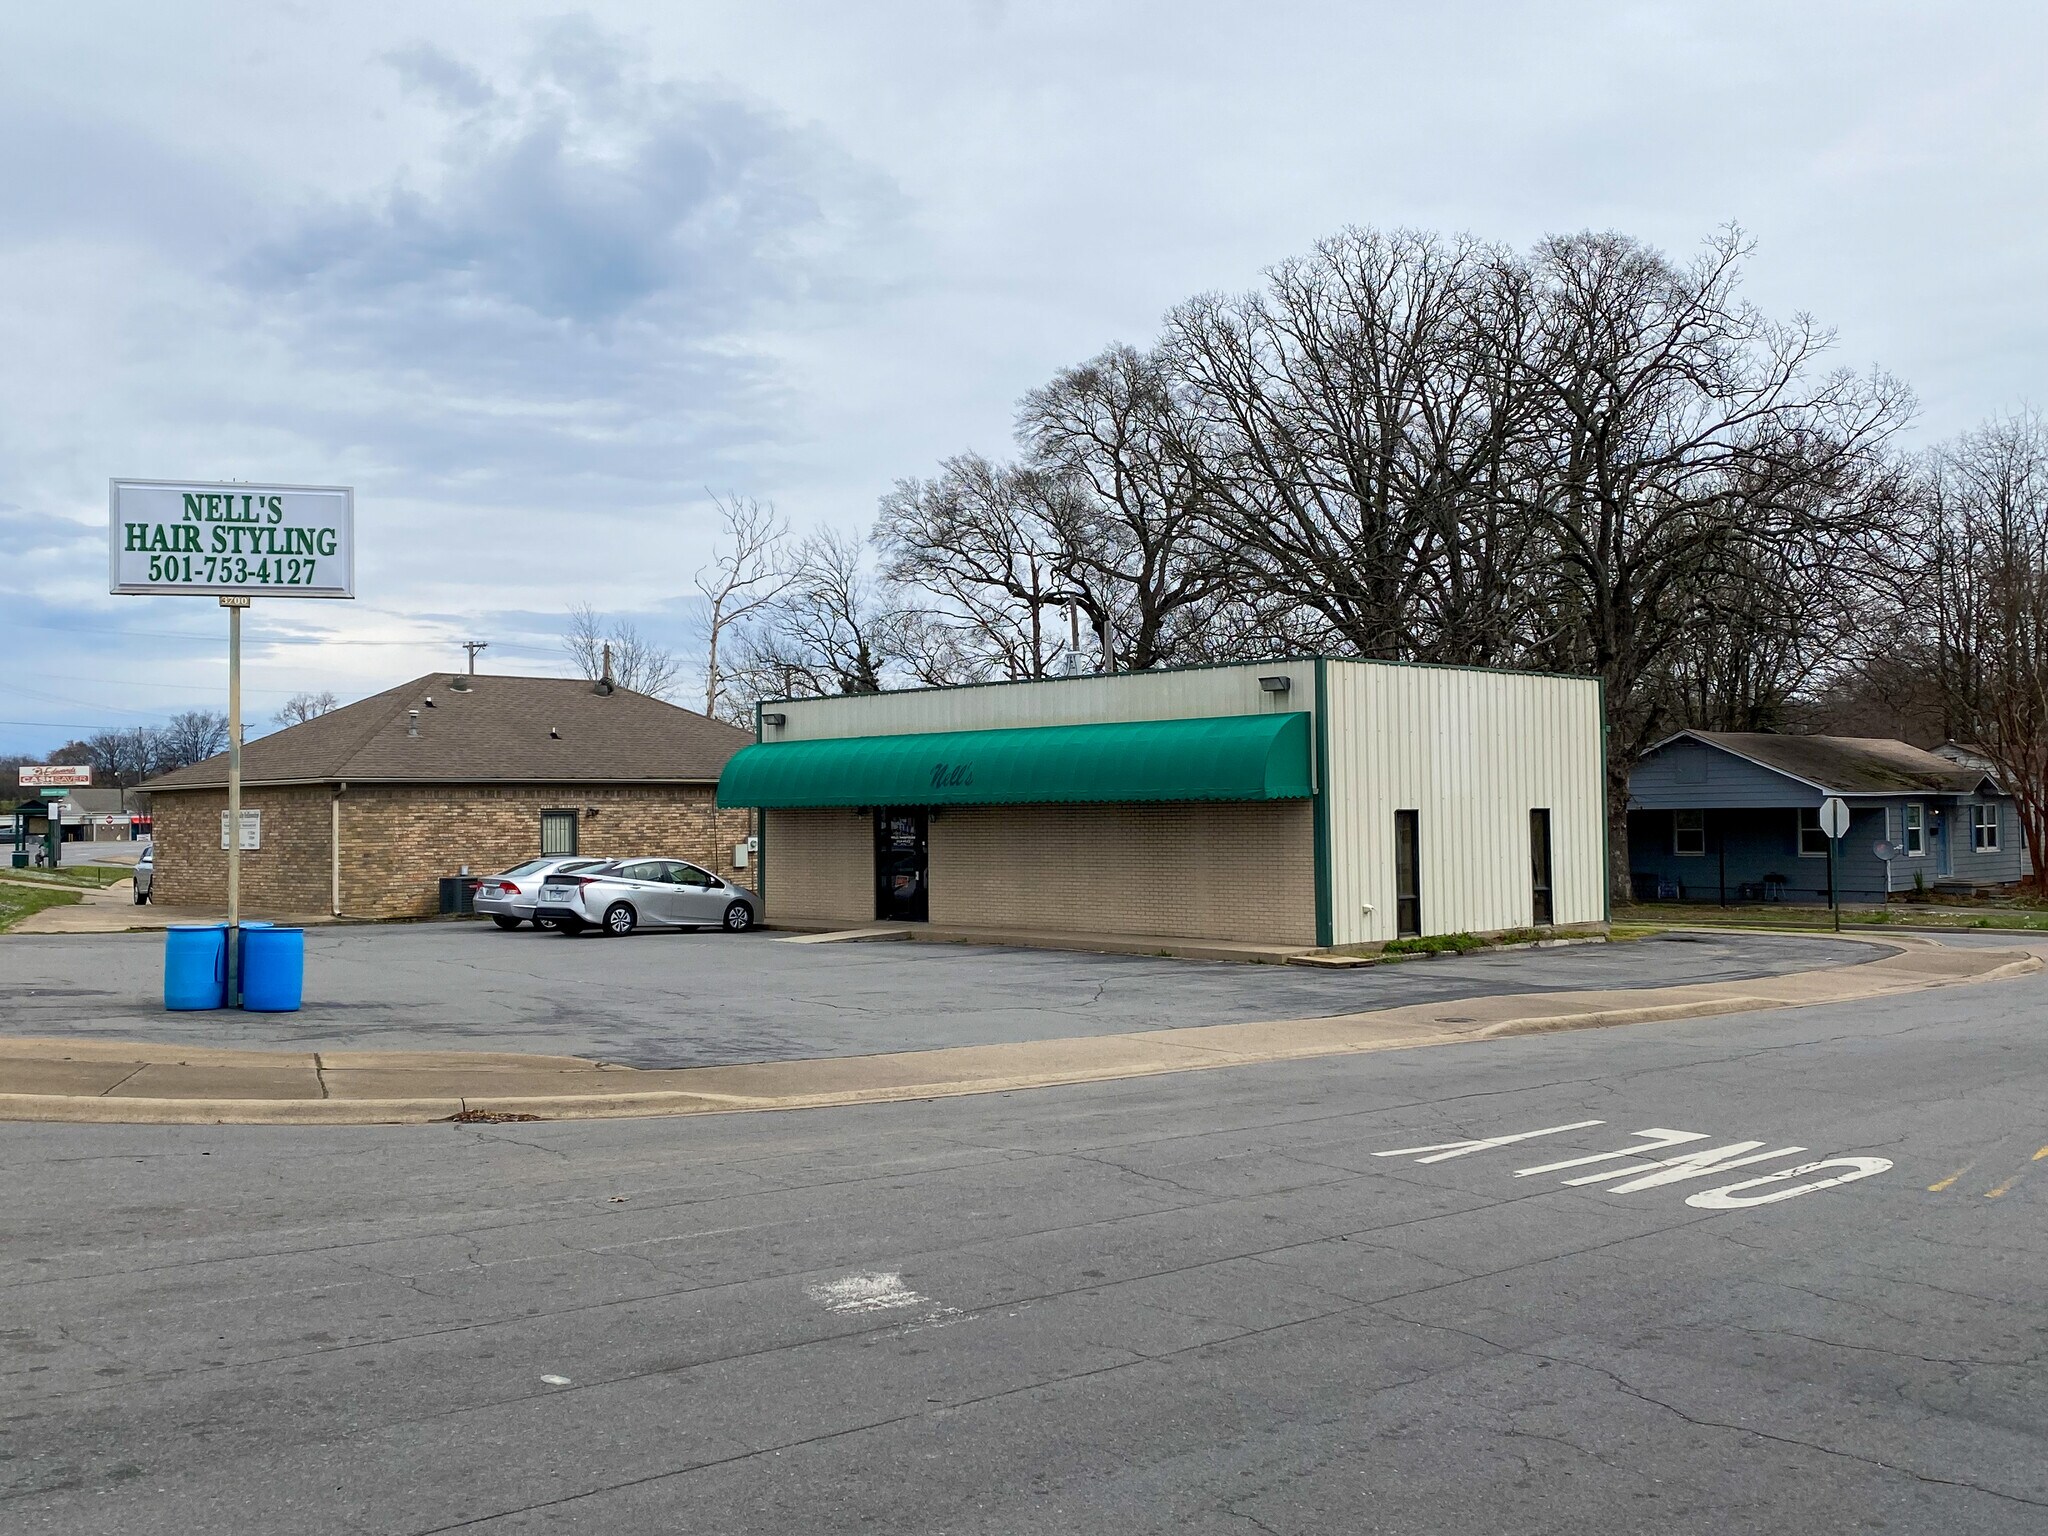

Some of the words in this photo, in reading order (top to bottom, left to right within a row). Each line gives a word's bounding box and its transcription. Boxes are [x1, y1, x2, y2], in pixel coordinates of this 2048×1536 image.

[182, 493, 283, 524] NELL'S
[125, 523, 204, 552] HAIR
[211, 525, 338, 556] STYLING
[148, 554, 316, 584] 501-753-4127
[221, 596, 247, 605] 3700
[930, 761, 974, 789] Nell's
[1370, 1120, 1894, 1209] ONLY
